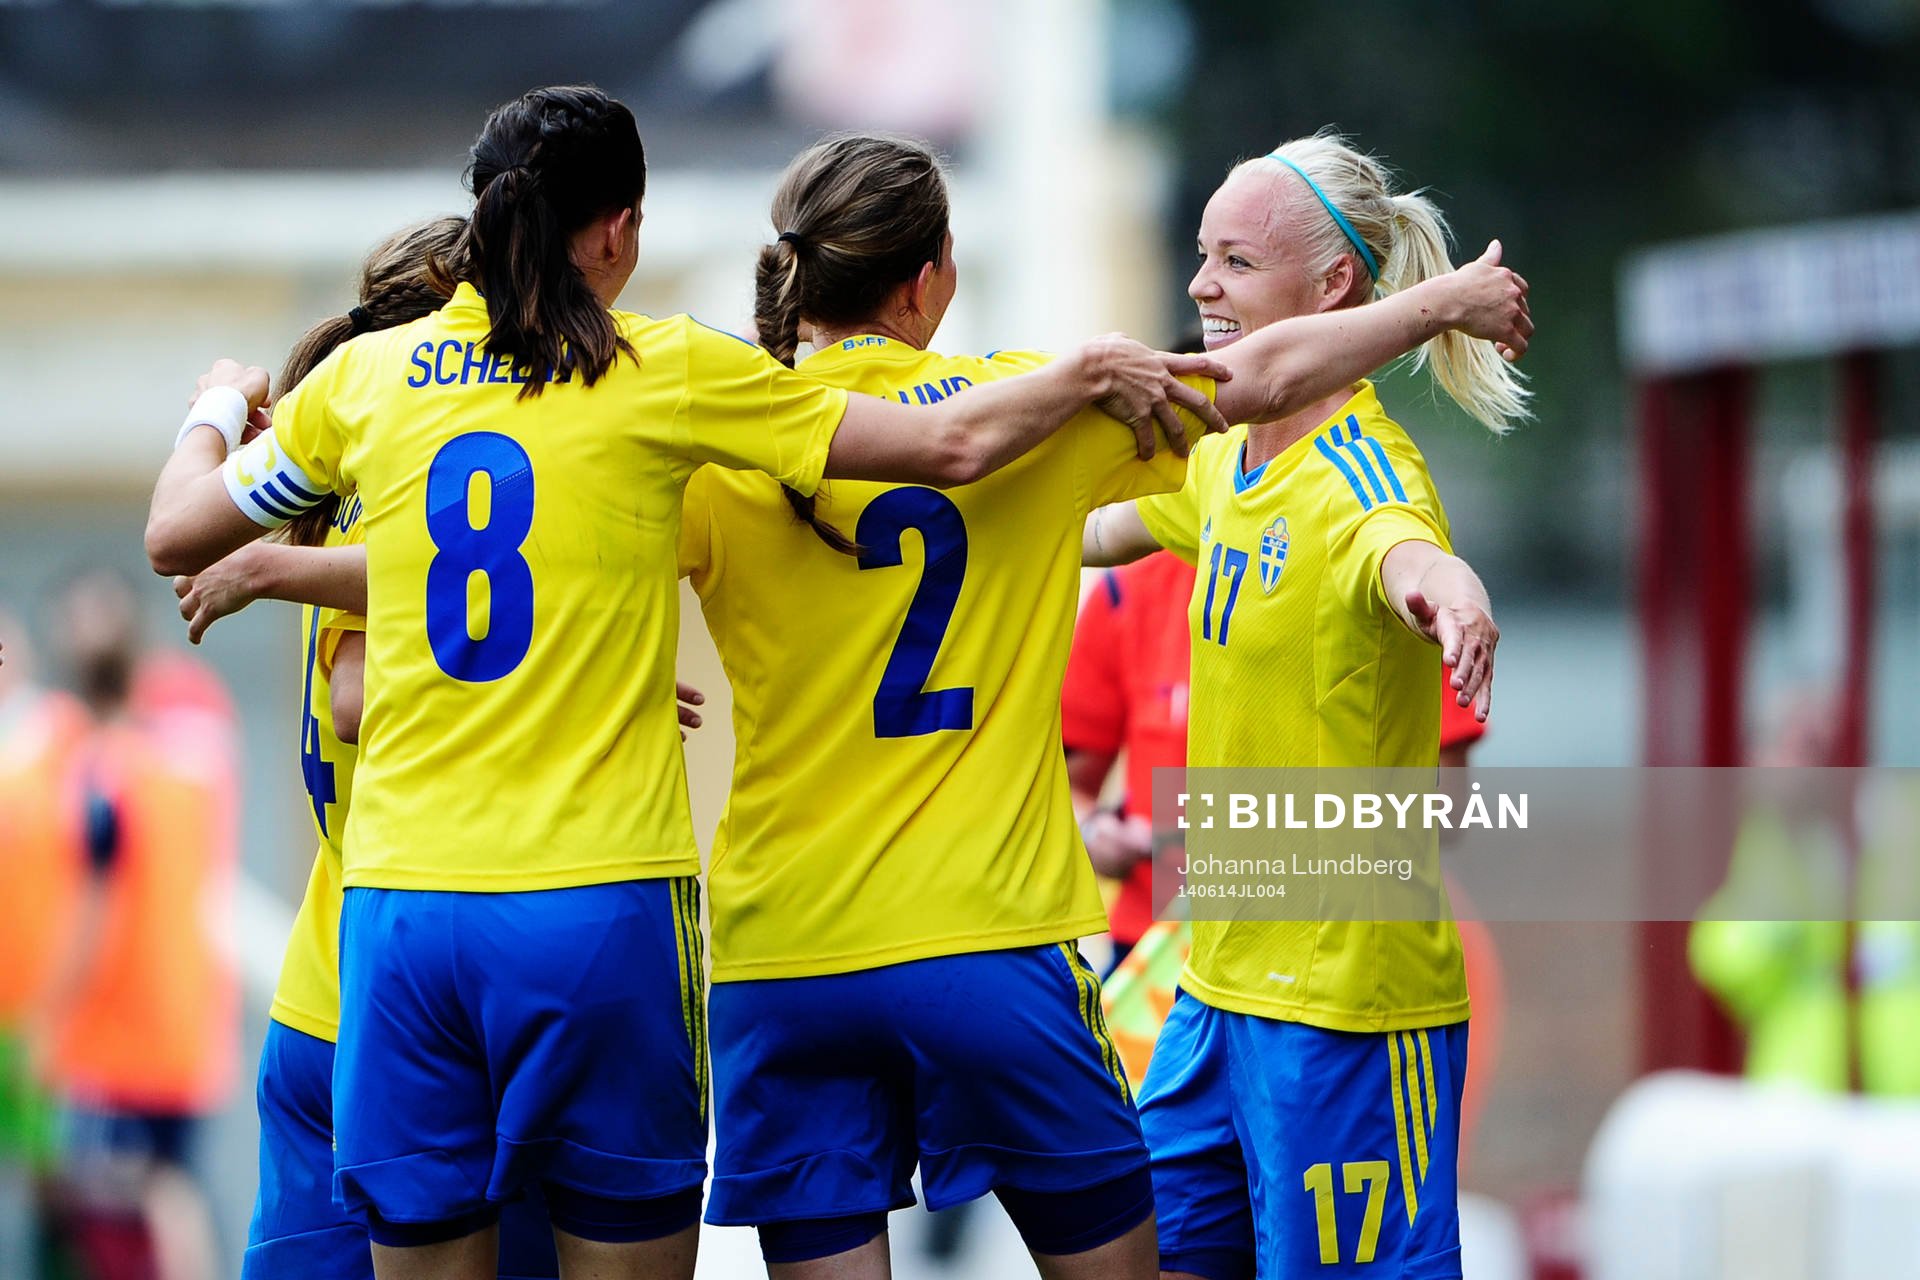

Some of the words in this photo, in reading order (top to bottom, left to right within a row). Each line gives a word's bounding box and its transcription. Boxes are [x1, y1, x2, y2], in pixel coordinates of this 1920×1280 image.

[425, 431, 535, 684] 8
[855, 485, 974, 738] 2
[1203, 542, 1249, 647] 17
[1304, 1160, 1390, 1264] 17
